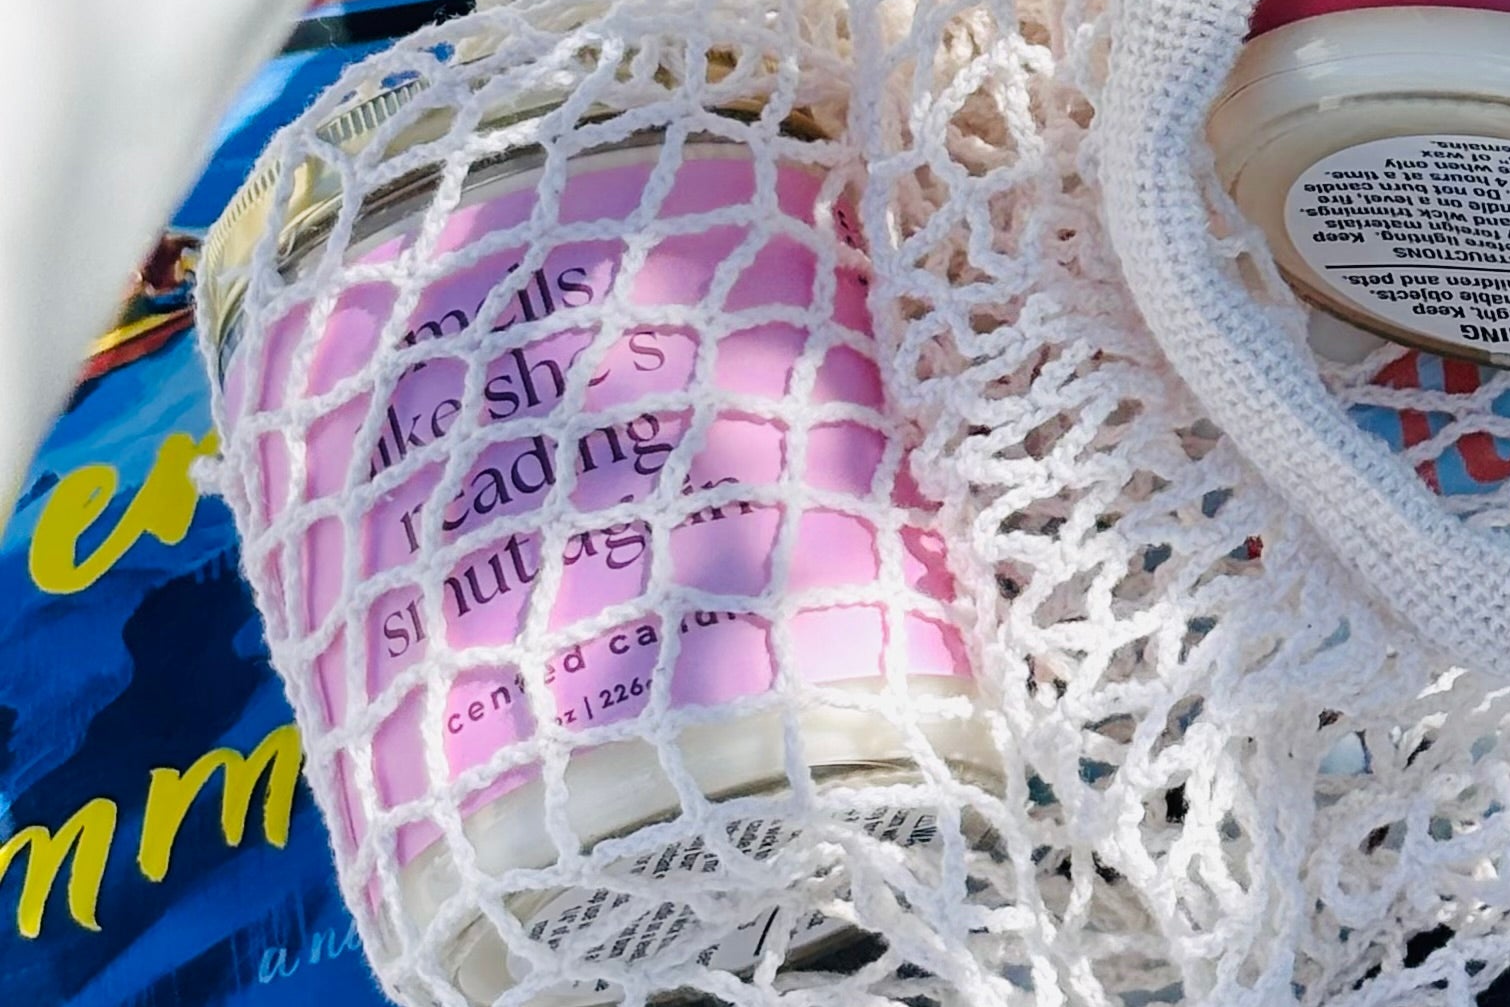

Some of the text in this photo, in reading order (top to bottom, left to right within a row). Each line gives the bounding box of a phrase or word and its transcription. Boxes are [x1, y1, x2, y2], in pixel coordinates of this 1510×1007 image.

[1385, 159, 1428, 169] only
[1434, 162, 1492, 172] when
[1326, 171, 1379, 180] time.
[1402, 172, 1422, 181] at
[1430, 173, 1490, 186] hours
[1304, 183, 1373, 193] candle
[1495, 178, 1507, 187] 4
[1379, 183, 1428, 194] burn
[1432, 185, 1467, 195] not
[1473, 188, 1500, 200] Do
[1318, 195, 1352, 204] fire
[1357, 193, 1412, 206] level,
[1437, 198, 1462, 207] on
[1300, 206, 1412, 217] trimmings.
[1418, 209, 1467, 222] wick
[1325, 220, 1422, 230] materials
[1473, 216, 1510, 226] and
[1428, 222, 1500, 240] foreign
[1313, 232, 1364, 243] Keep
[1376, 230, 1459, 246] lighting.
[1342, 273, 1394, 286] pets.
[1400, 276, 1439, 287] and
[1370, 289, 1453, 302] objects.
[1413, 303, 1464, 318] Keep
